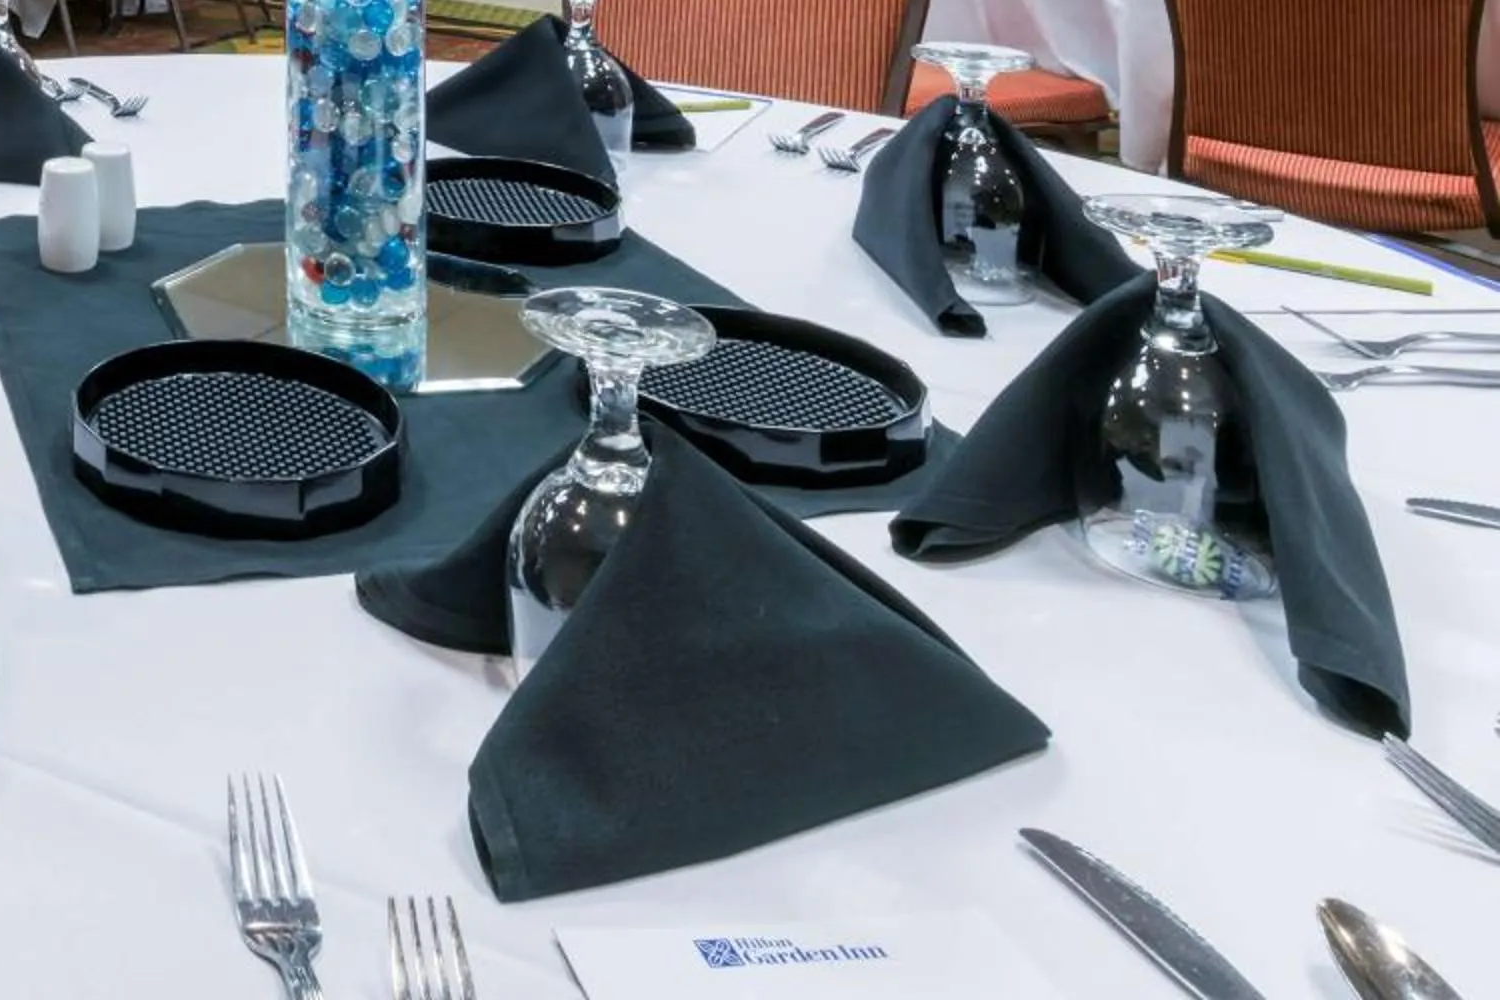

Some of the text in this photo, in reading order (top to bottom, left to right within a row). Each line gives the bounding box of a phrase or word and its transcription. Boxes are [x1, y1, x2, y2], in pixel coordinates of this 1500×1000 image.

[734, 937, 793, 950] Hilton
[743, 944, 888, 966] Garden Inn
